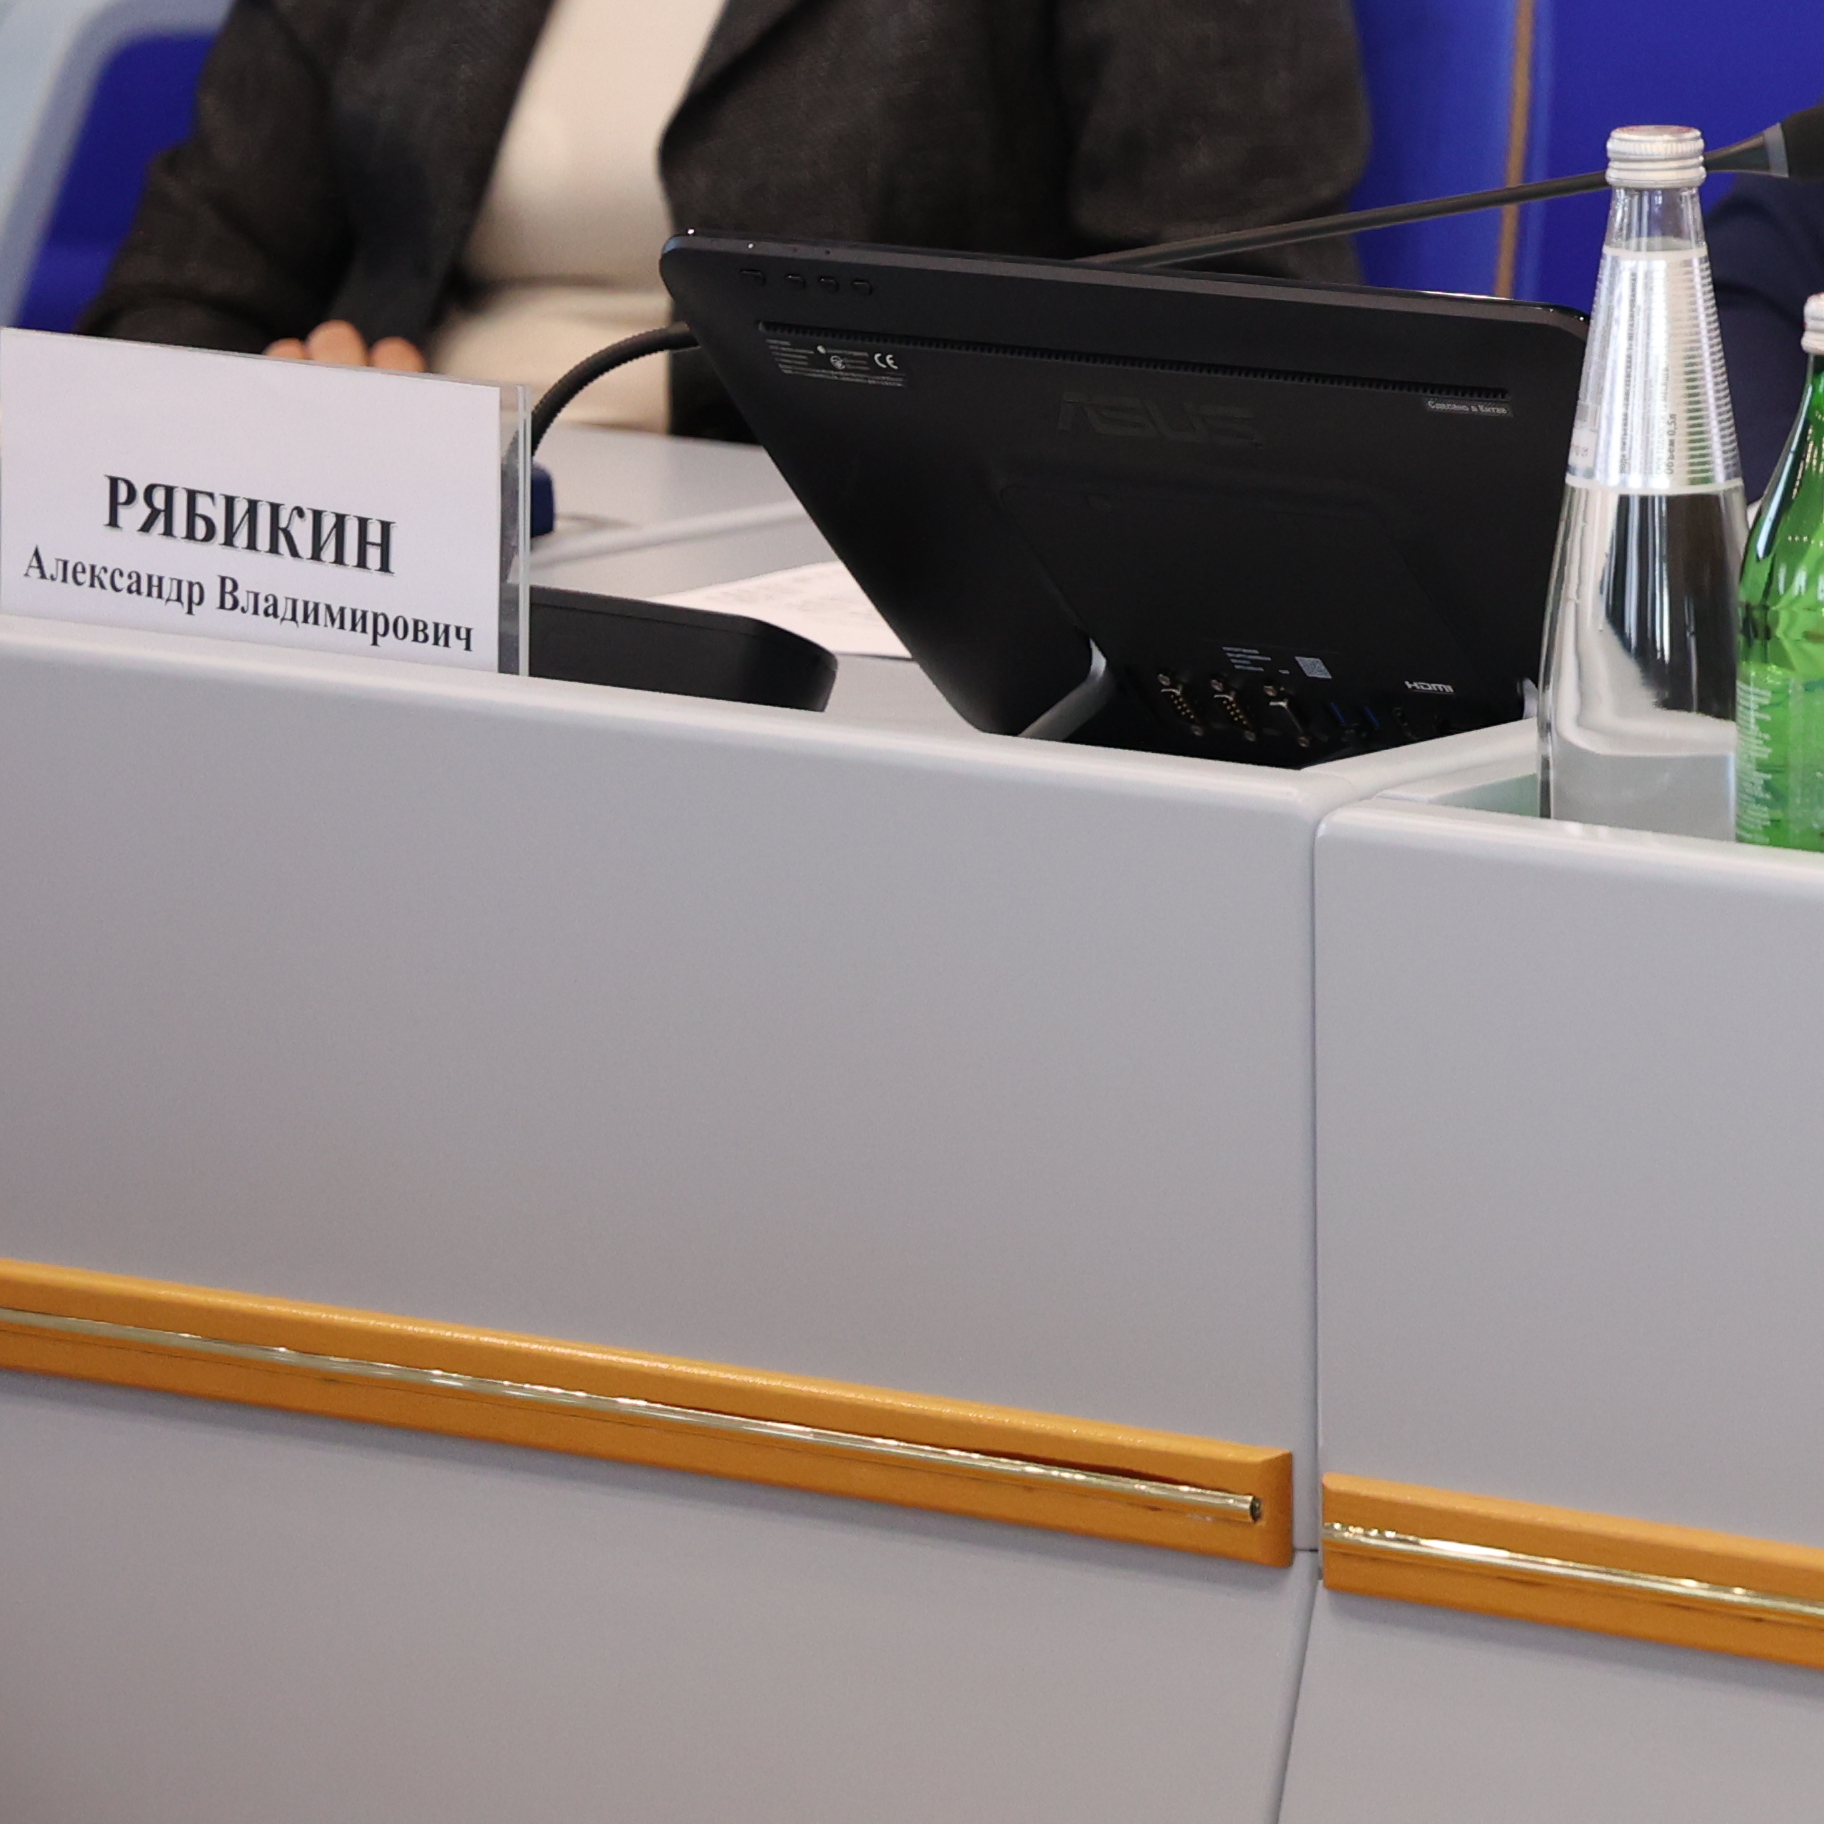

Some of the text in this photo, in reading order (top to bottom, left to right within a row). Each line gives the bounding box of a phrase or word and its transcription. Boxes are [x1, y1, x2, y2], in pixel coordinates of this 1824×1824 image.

[104, 474, 396, 576] РЯБИКИН
[23, 545, 473, 653] Александр Владимирович
